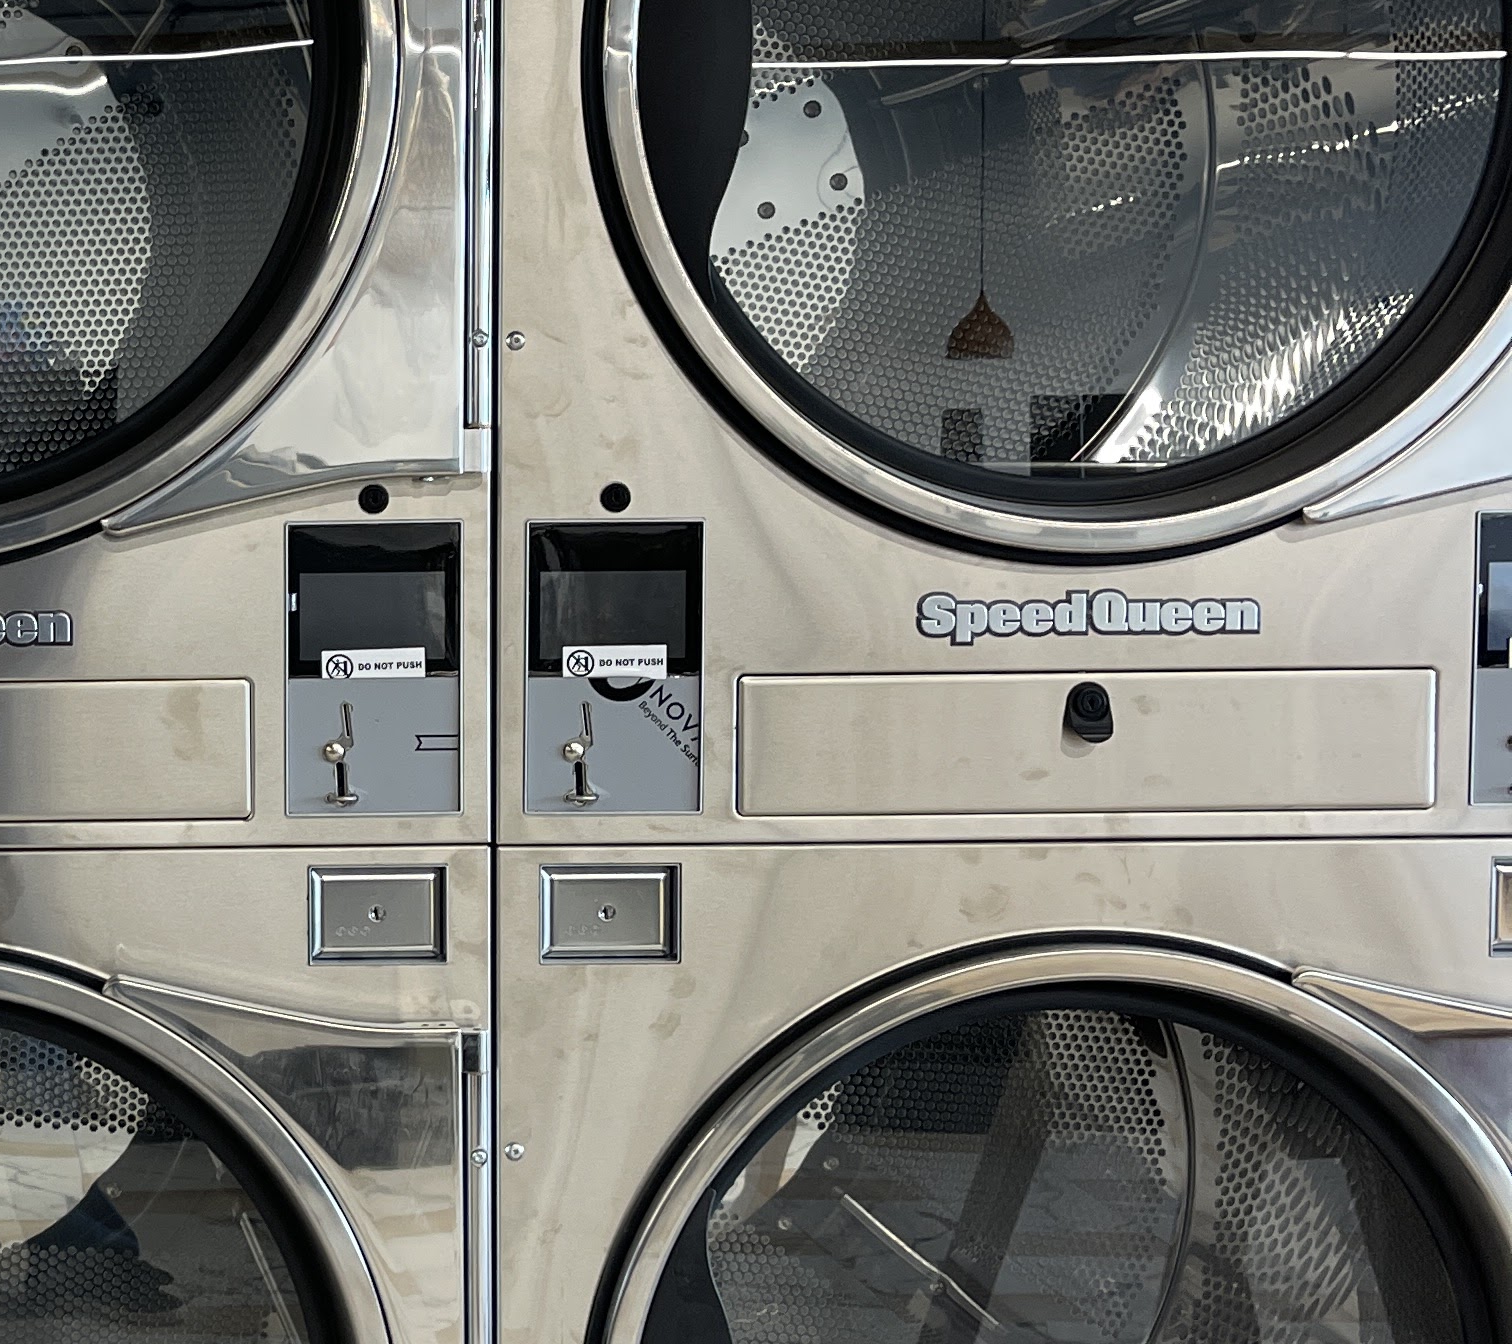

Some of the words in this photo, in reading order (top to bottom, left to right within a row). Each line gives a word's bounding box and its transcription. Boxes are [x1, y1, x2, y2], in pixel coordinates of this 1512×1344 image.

[917, 589, 1089, 646] Speed
[1089, 588, 1260, 634] Queen
[358, 661, 371, 670] DO
[374, 661, 393, 670] NOT
[396, 660, 422, 670] PUSH
[599, 658, 612, 667] DO
[615, 658, 635, 666] NOT
[638, 657, 663, 666] PUSH
[638, 700, 669, 731] Beyond
[666, 727, 682, 747] The
